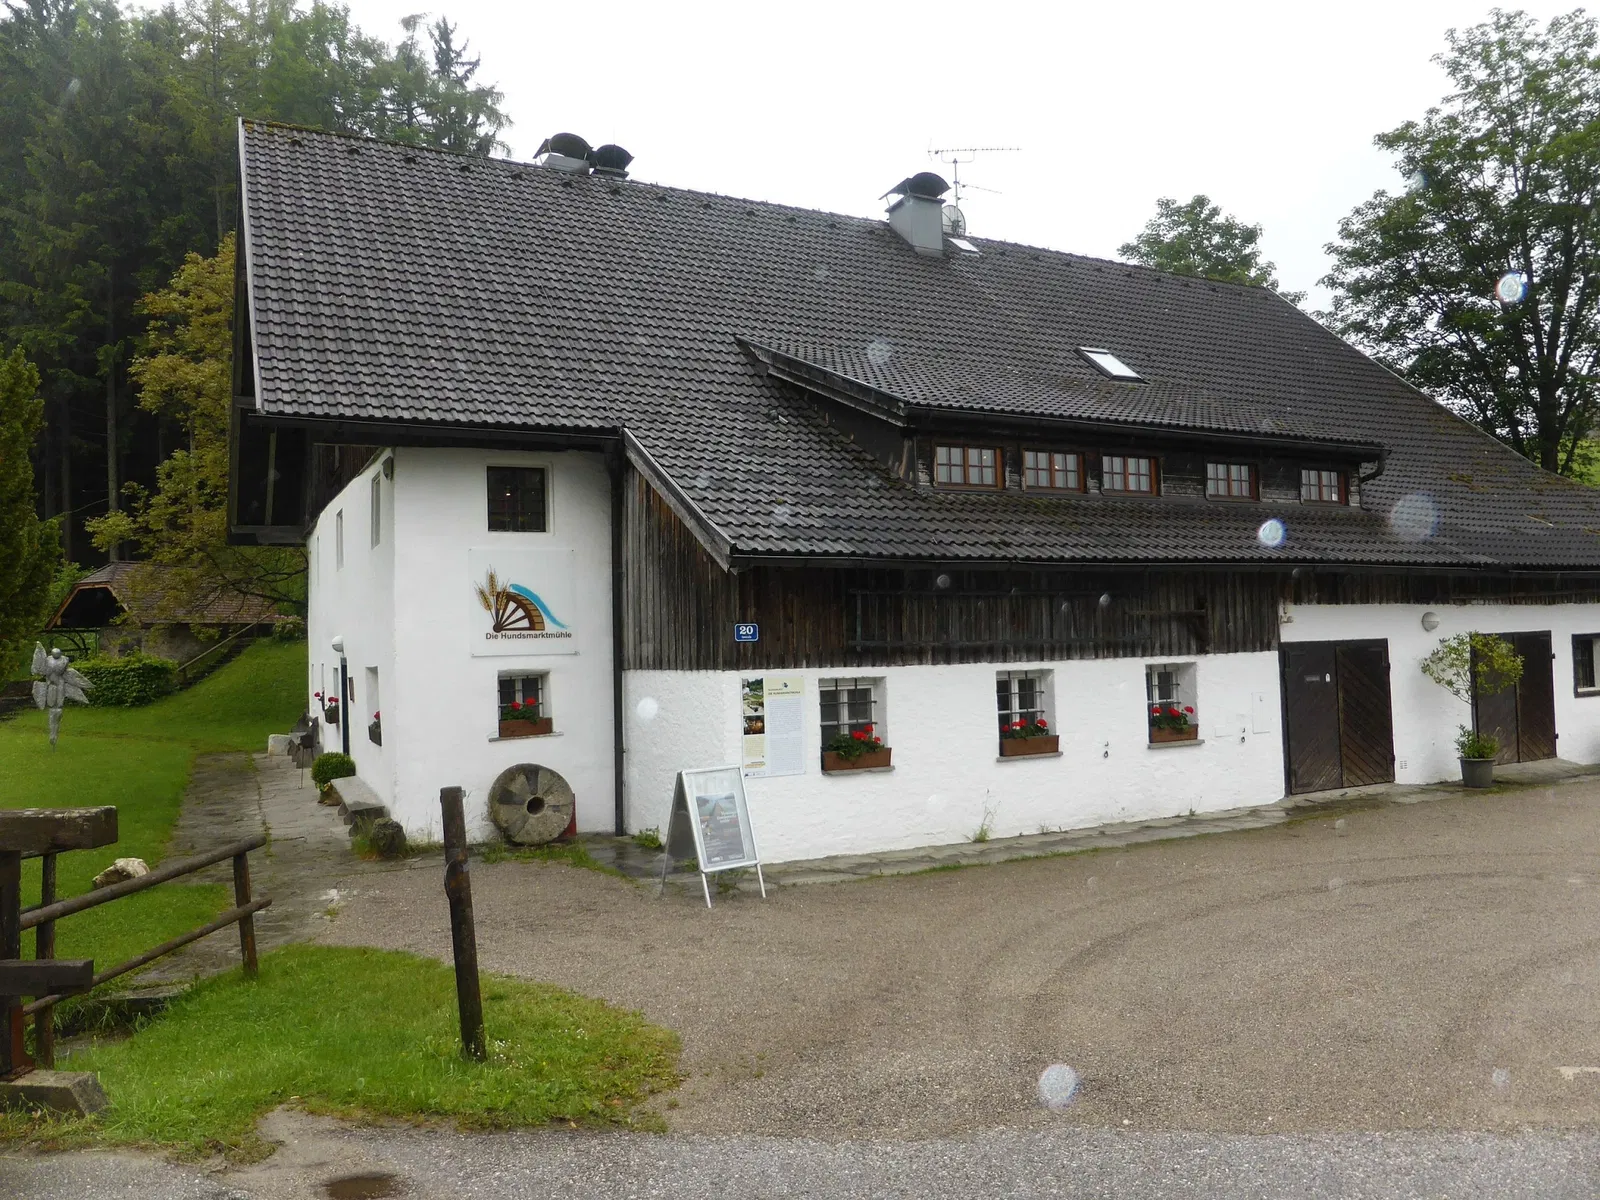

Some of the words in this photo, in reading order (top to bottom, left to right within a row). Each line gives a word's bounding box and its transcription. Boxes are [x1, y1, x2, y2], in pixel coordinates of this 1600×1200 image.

[740, 625, 753, 635] 20
[485, 632, 499, 640] Die
[500, 631, 572, 640] Hundsmarktmühle
